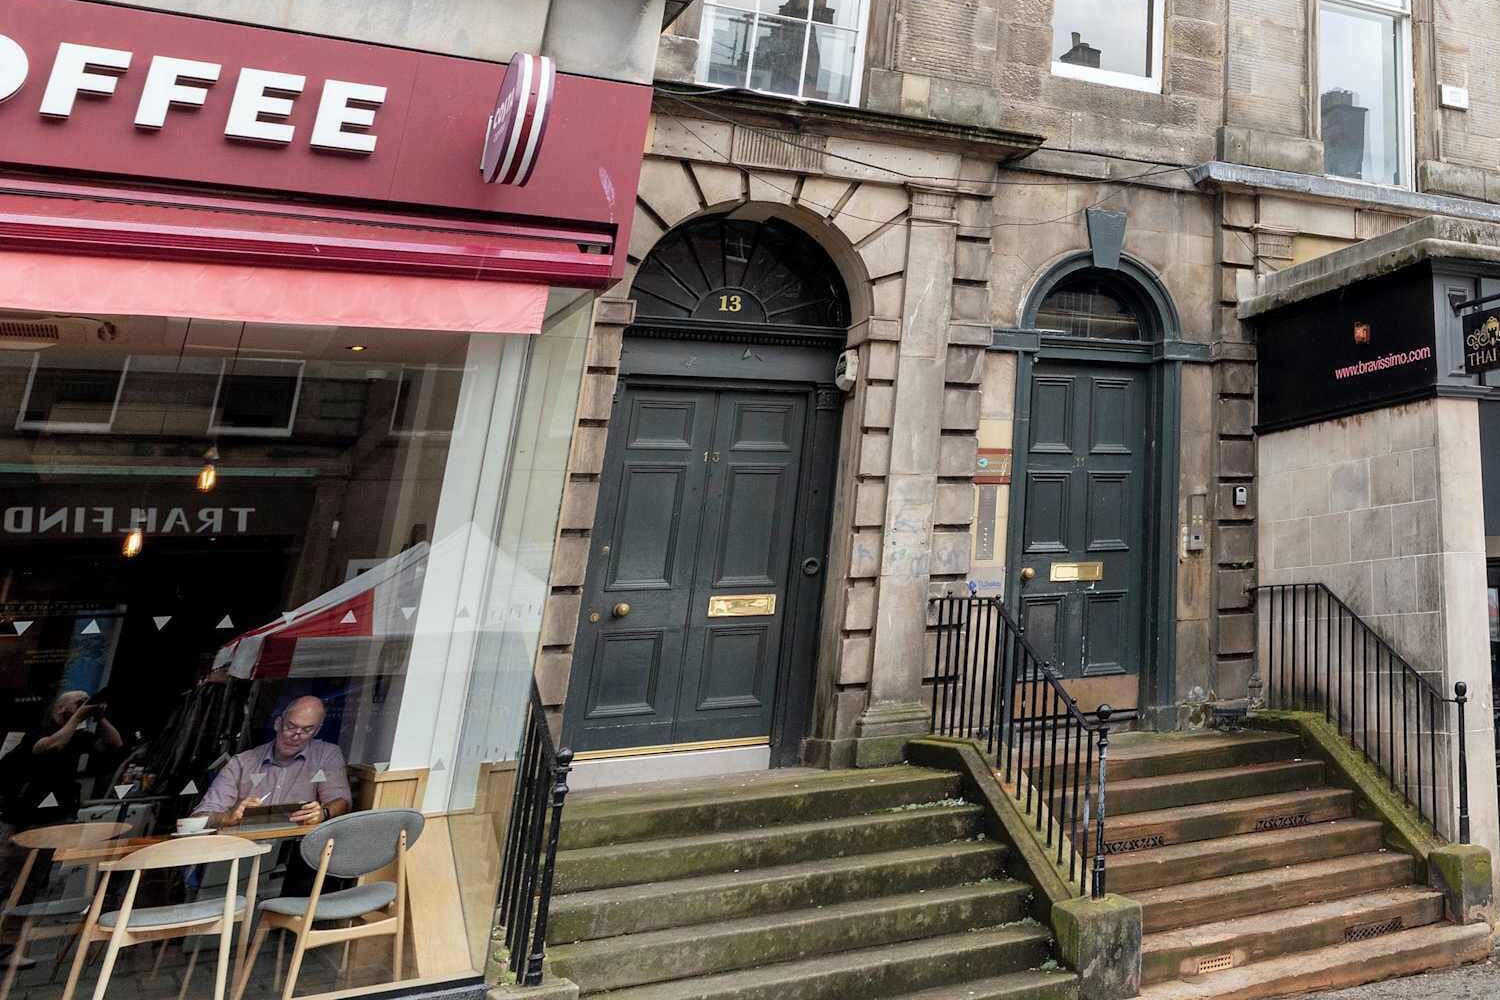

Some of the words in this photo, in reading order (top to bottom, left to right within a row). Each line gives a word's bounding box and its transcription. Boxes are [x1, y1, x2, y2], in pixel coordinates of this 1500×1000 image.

[719, 295, 742, 312] 13
[1335, 346, 1431, 380] www.bravissimo.com
[1467, 351, 1497, 367] THAI
